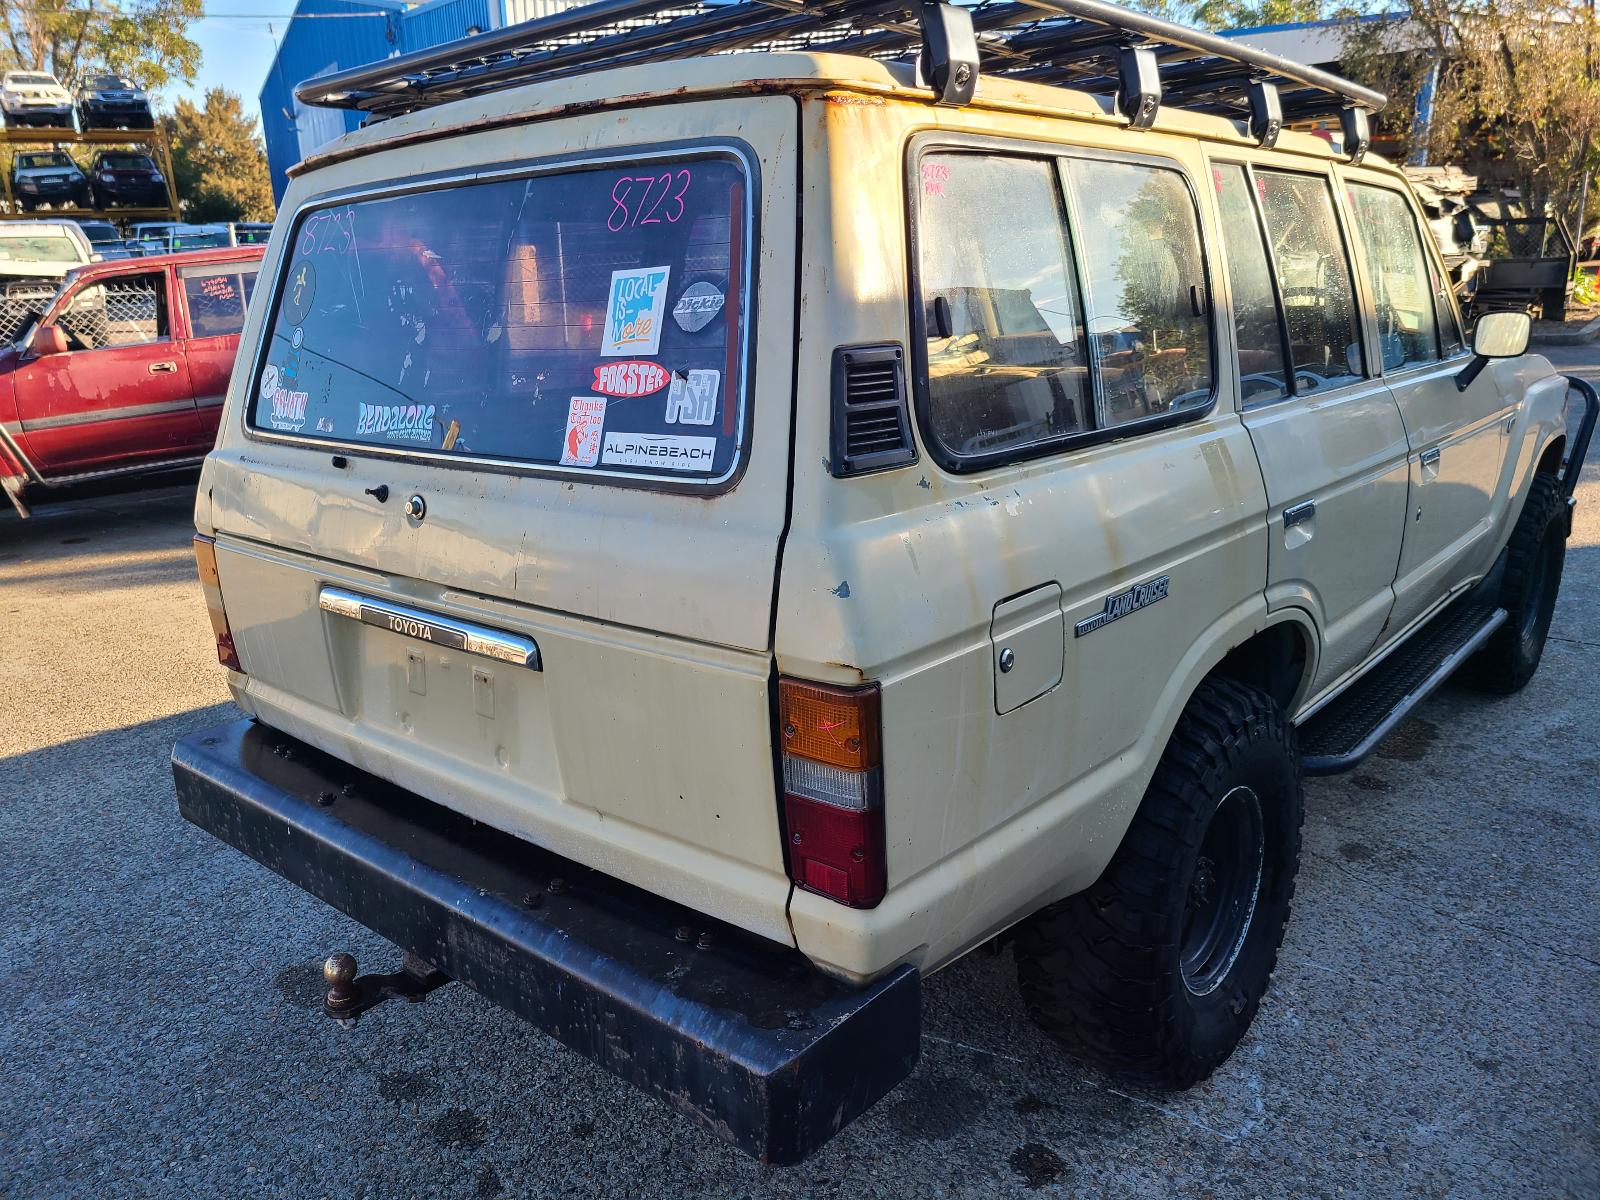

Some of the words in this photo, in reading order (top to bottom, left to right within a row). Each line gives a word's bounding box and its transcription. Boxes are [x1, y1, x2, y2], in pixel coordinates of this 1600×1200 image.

[607, 169, 691, 232] 8723
[617, 274, 656, 301] LOCAL
[599, 363, 664, 394] FORSTER
[572, 399, 604, 412] Thanks
[605, 443, 712, 460] ALPINEBEACH
[388, 615, 432, 641] TOYOTA
[1080, 612, 1107, 636] TOYOTA
